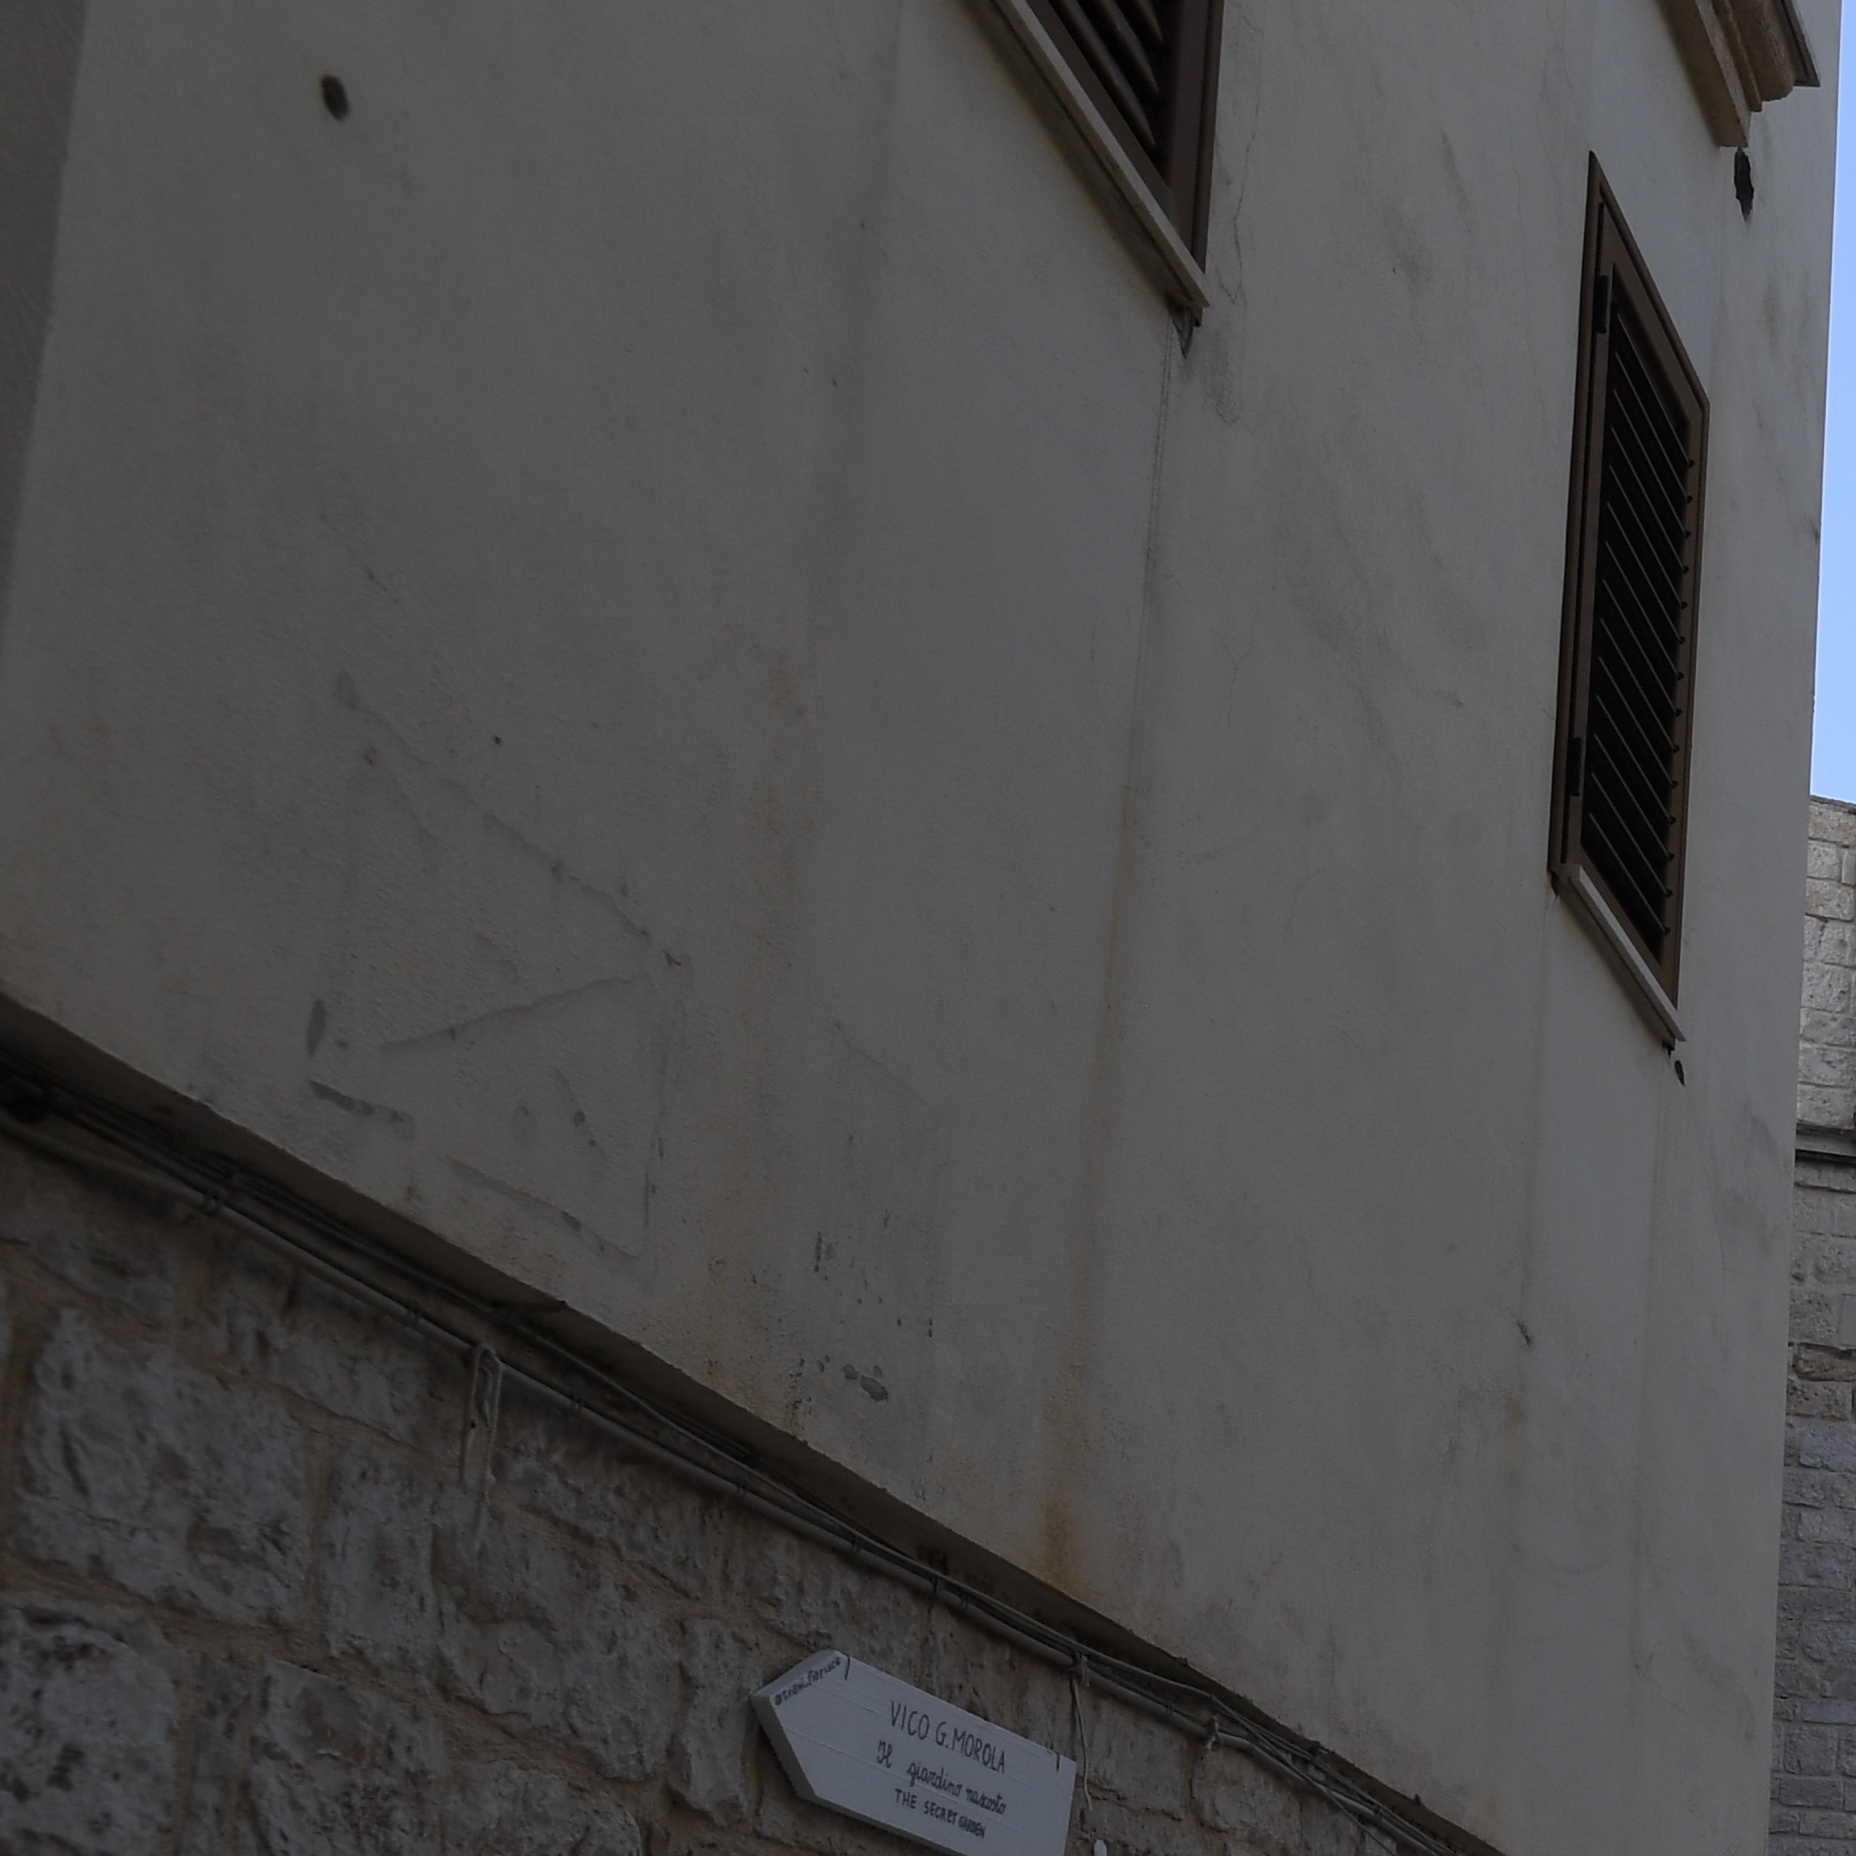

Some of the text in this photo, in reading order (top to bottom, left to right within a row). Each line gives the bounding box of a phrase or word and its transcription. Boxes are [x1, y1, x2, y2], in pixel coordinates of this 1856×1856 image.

[891, 1700, 930, 1740] VICO
[876, 1739, 1007, 1815] Il giardino nascosto
[895, 1788, 987, 1838] THE SECRET GARDEN
